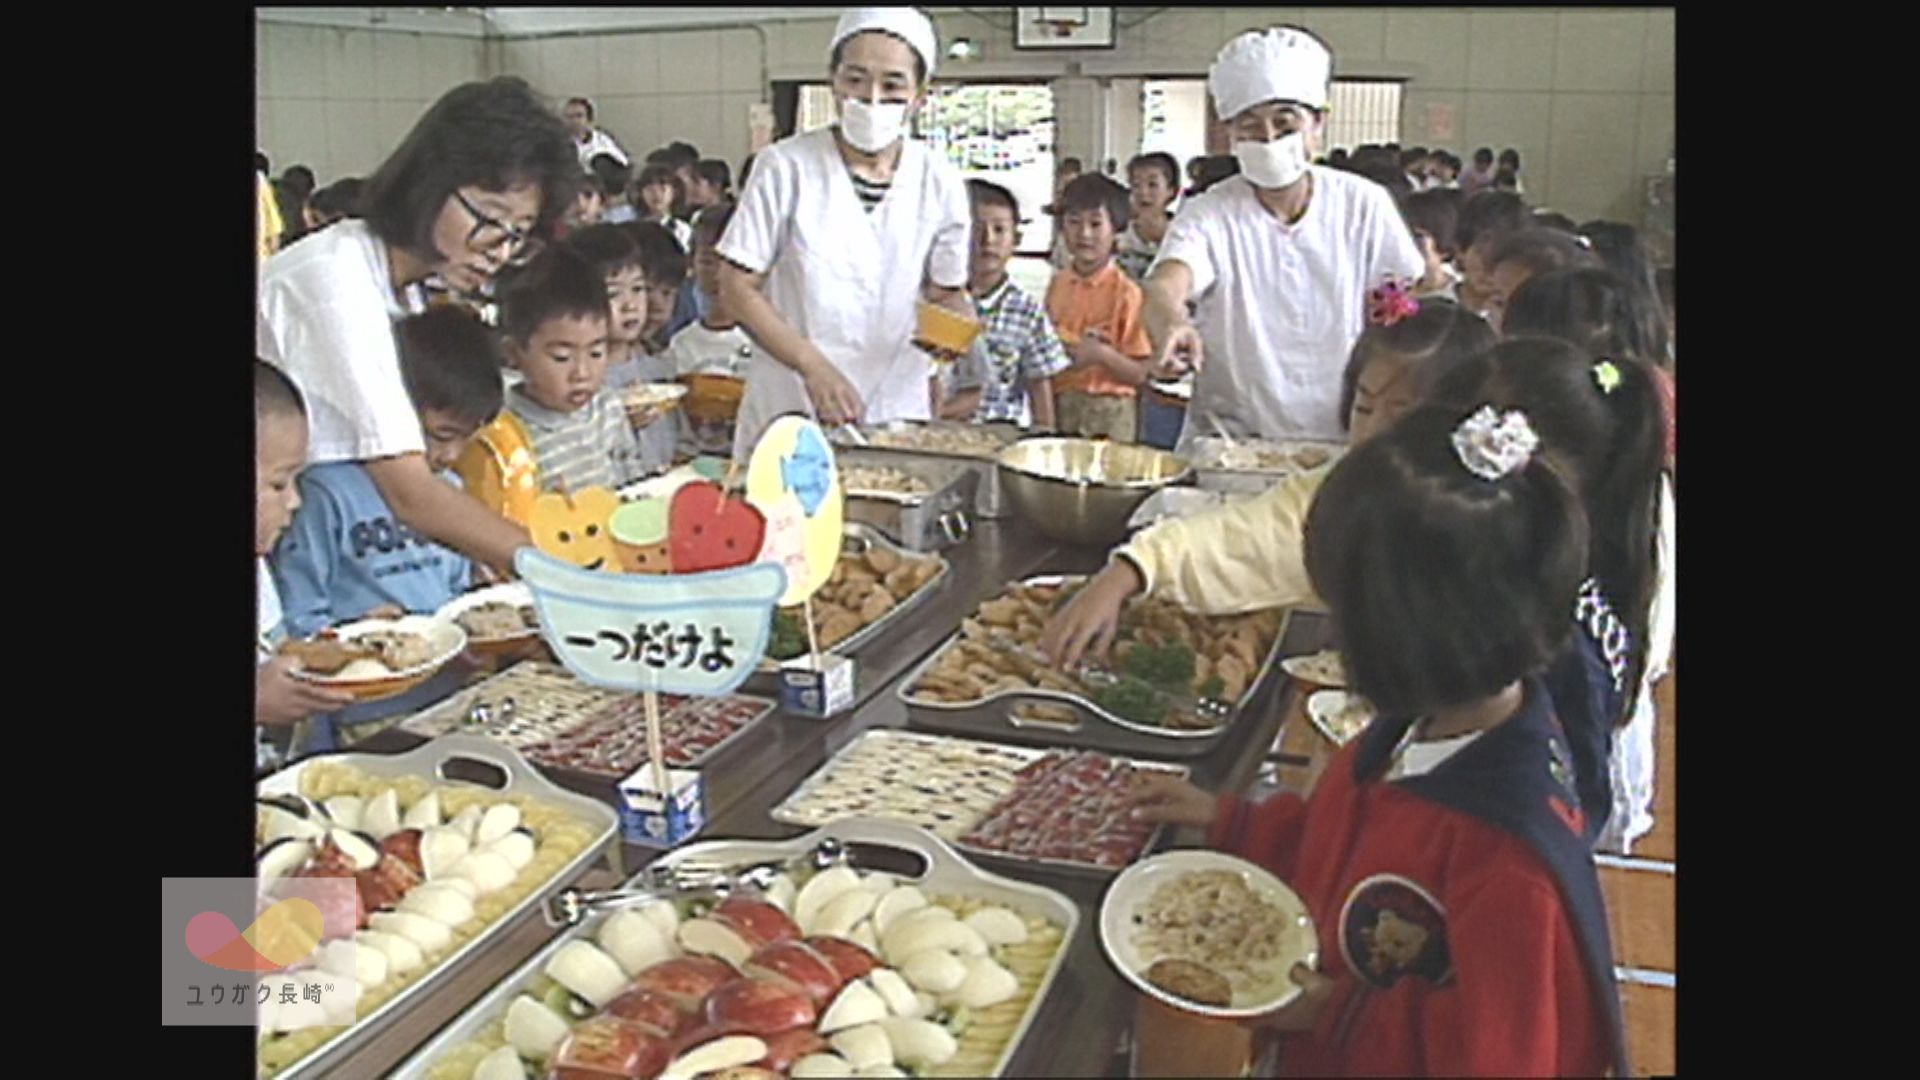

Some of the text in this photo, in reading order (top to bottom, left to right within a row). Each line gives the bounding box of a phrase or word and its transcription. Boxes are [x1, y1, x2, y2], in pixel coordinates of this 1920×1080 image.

[564, 620, 735, 672] 一つだけよ
